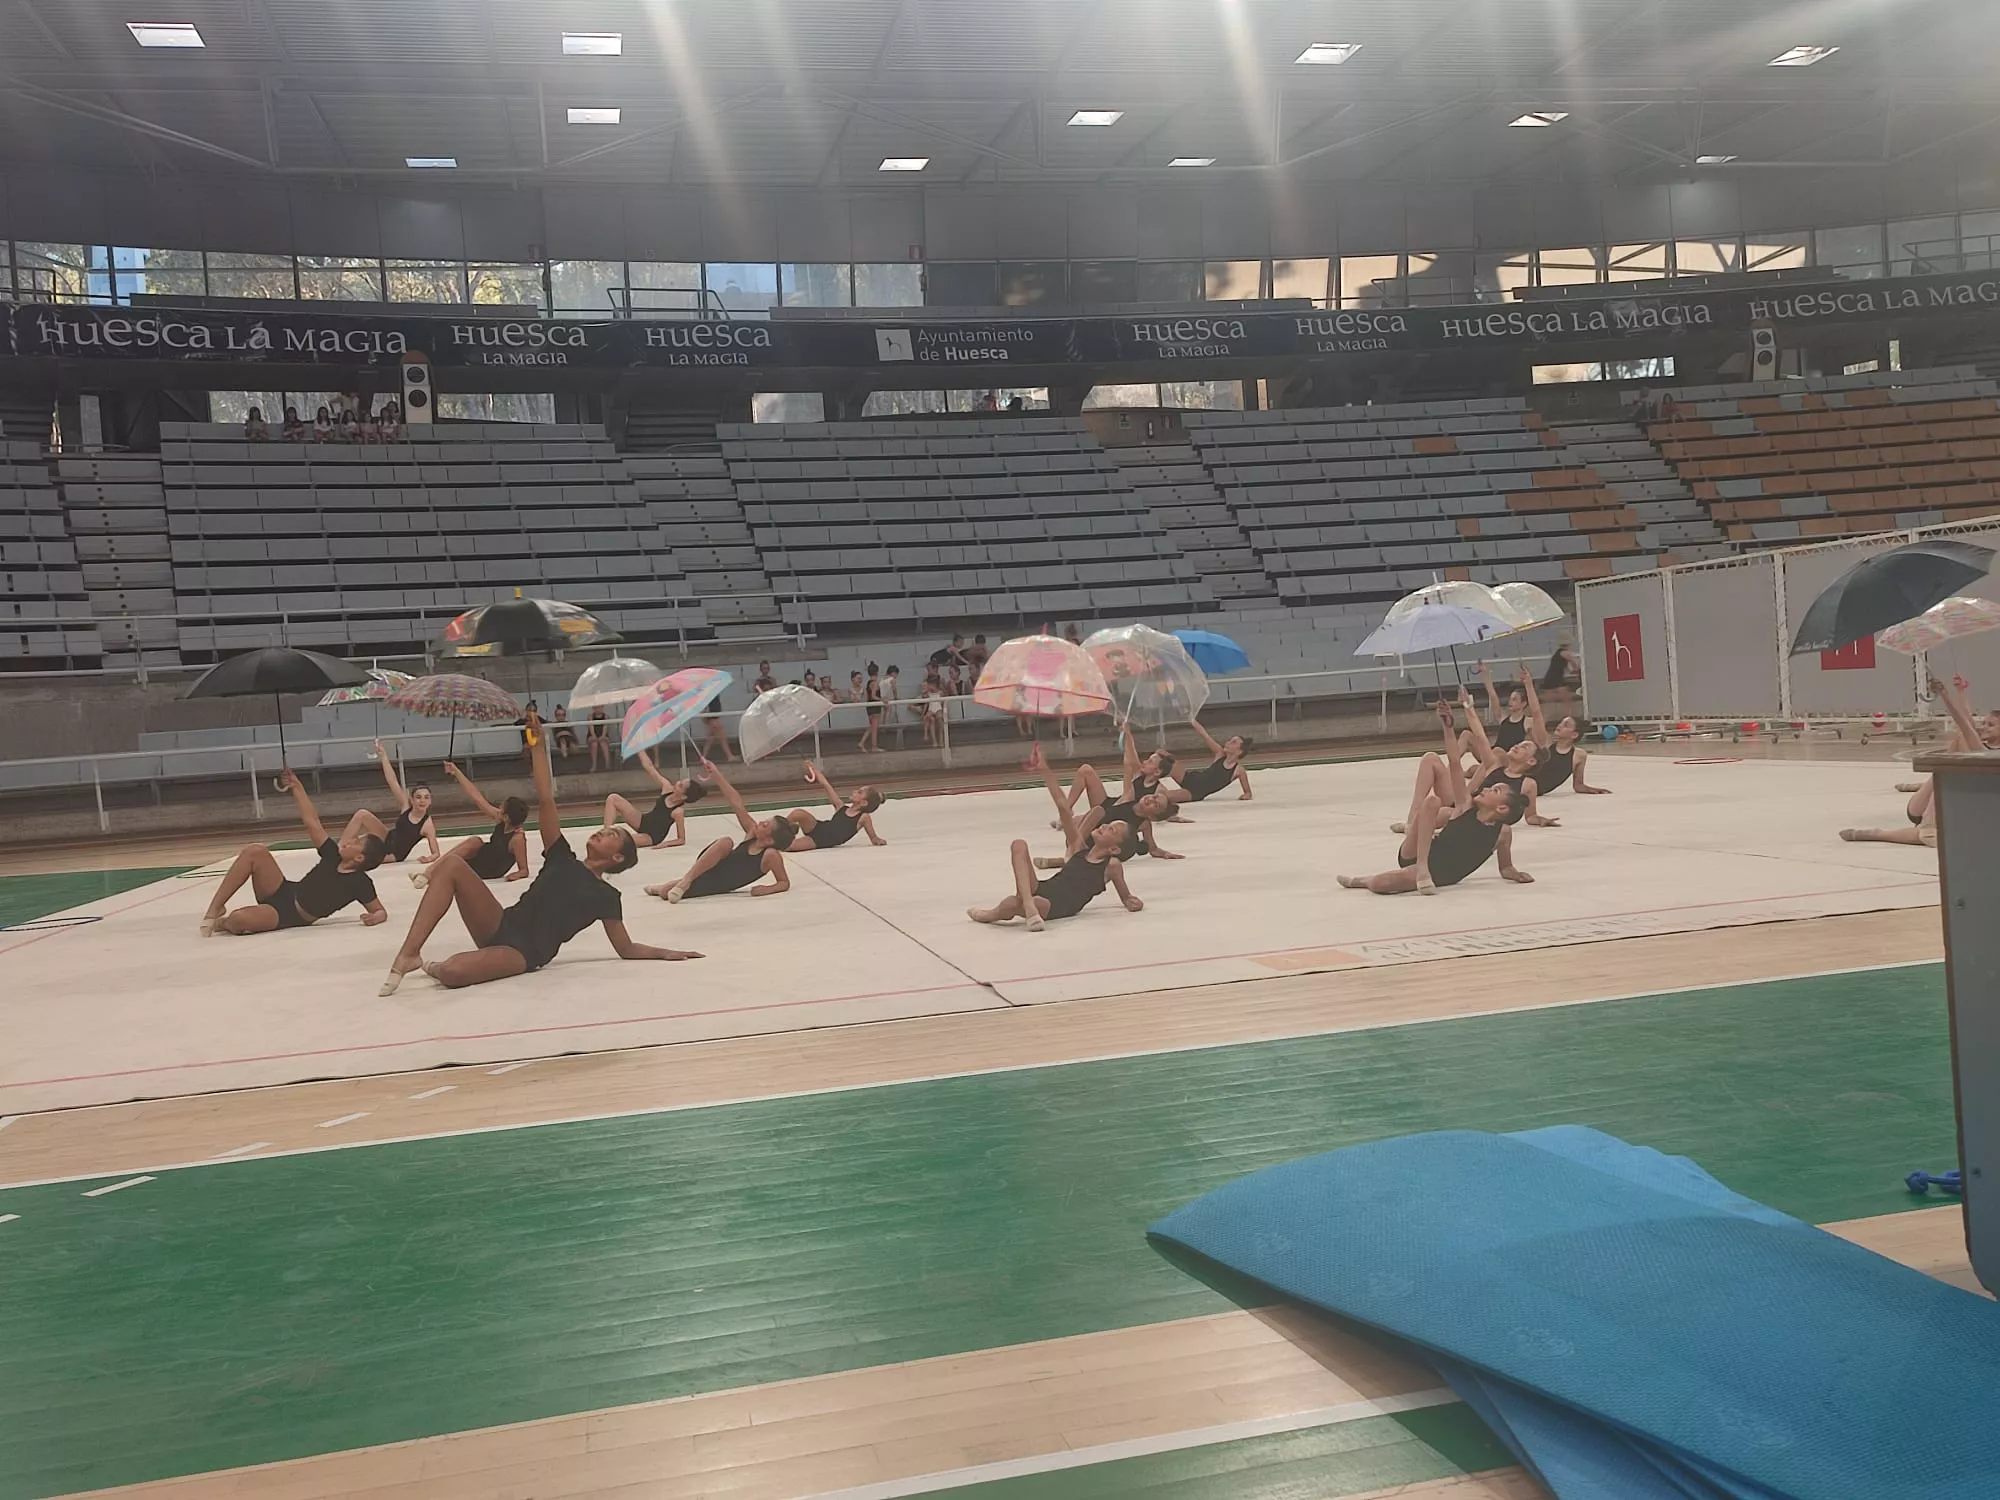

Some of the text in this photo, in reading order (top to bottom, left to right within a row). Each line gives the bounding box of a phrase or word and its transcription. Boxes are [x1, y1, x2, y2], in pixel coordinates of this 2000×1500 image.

[1748, 292, 1876, 319] Huesca
[37, 318, 214, 349] Huesca
[450, 323, 589, 347] Huesca
[644, 324, 772, 347] Huesca
[1132, 319, 1247, 341] Huesca
[1295, 313, 1408, 335] Huesca
[1440, 312, 1564, 338] Huesca
[918, 328, 1034, 347] Ayuntamiento
[920, 347, 1009, 361] de Huesca
